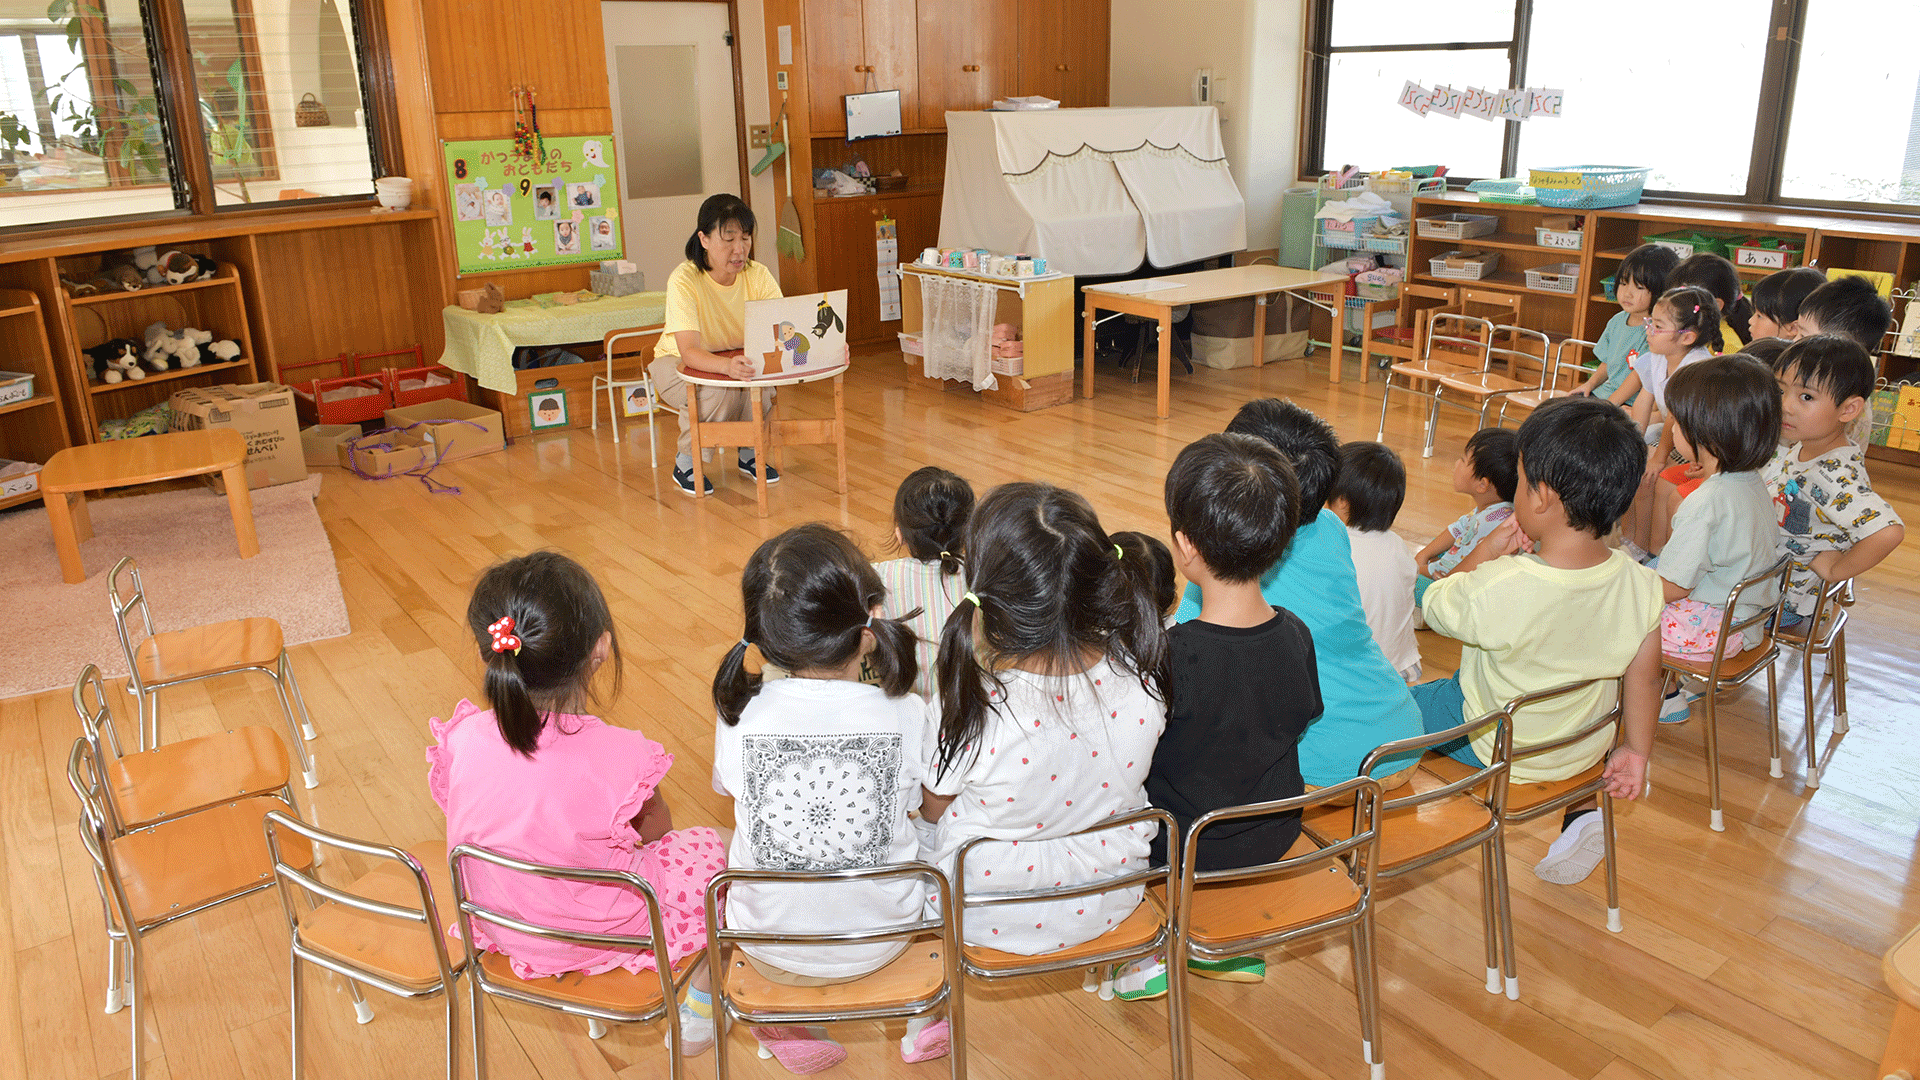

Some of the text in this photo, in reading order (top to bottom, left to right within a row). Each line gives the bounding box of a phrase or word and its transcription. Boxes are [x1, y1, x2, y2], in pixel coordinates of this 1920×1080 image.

[454, 158, 468, 180] 8
[503, 160, 573, 177] おともだち
[519, 178, 532, 198] 9
[1745, 252, 1777, 265] あか
